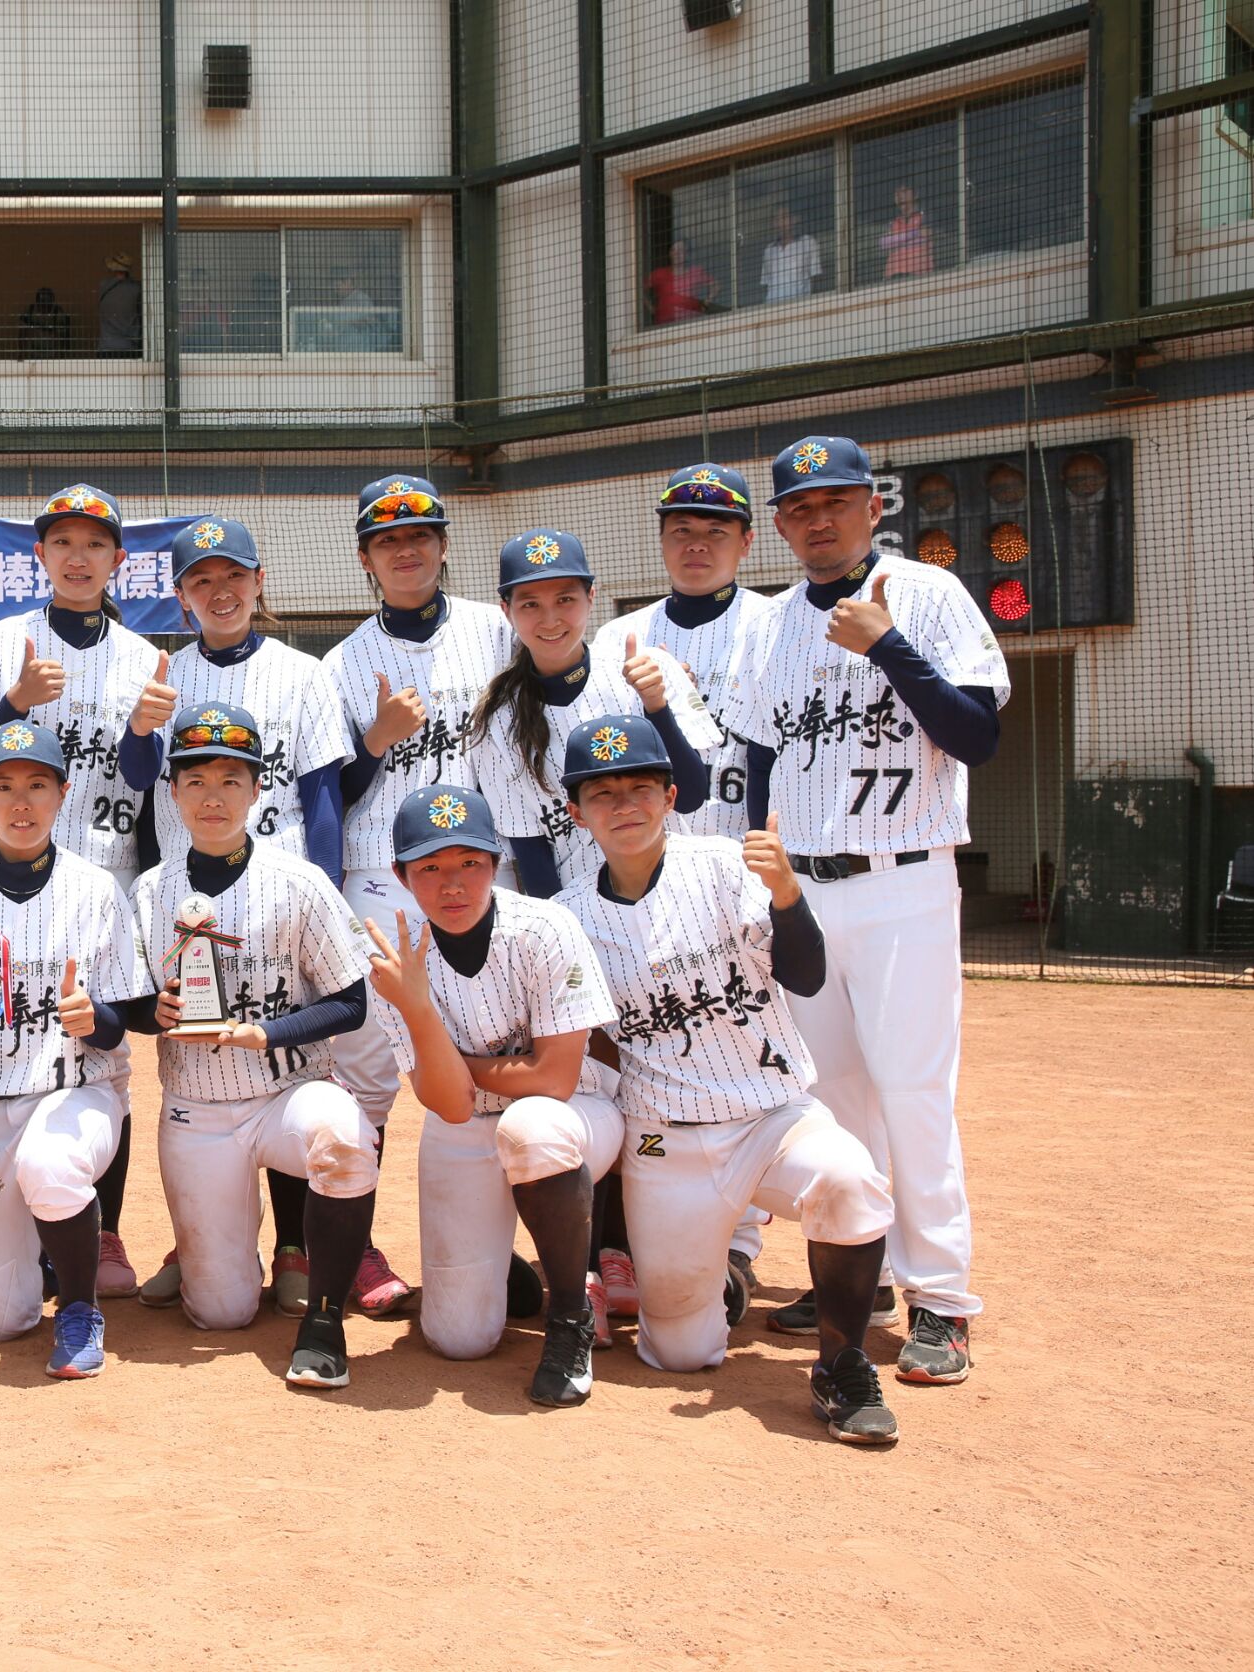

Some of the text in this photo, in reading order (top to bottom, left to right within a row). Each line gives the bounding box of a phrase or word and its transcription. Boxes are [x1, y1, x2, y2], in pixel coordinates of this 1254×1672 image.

[873, 475, 904, 516] B
[849, 768, 914, 816] 77
[93, 796, 134, 835] 26
[225, 953, 293, 972] 頂新和德
[666, 937, 739, 976] 頂新和德
[52, 1053, 87, 1090] 17
[759, 1038, 790, 1075] 4
